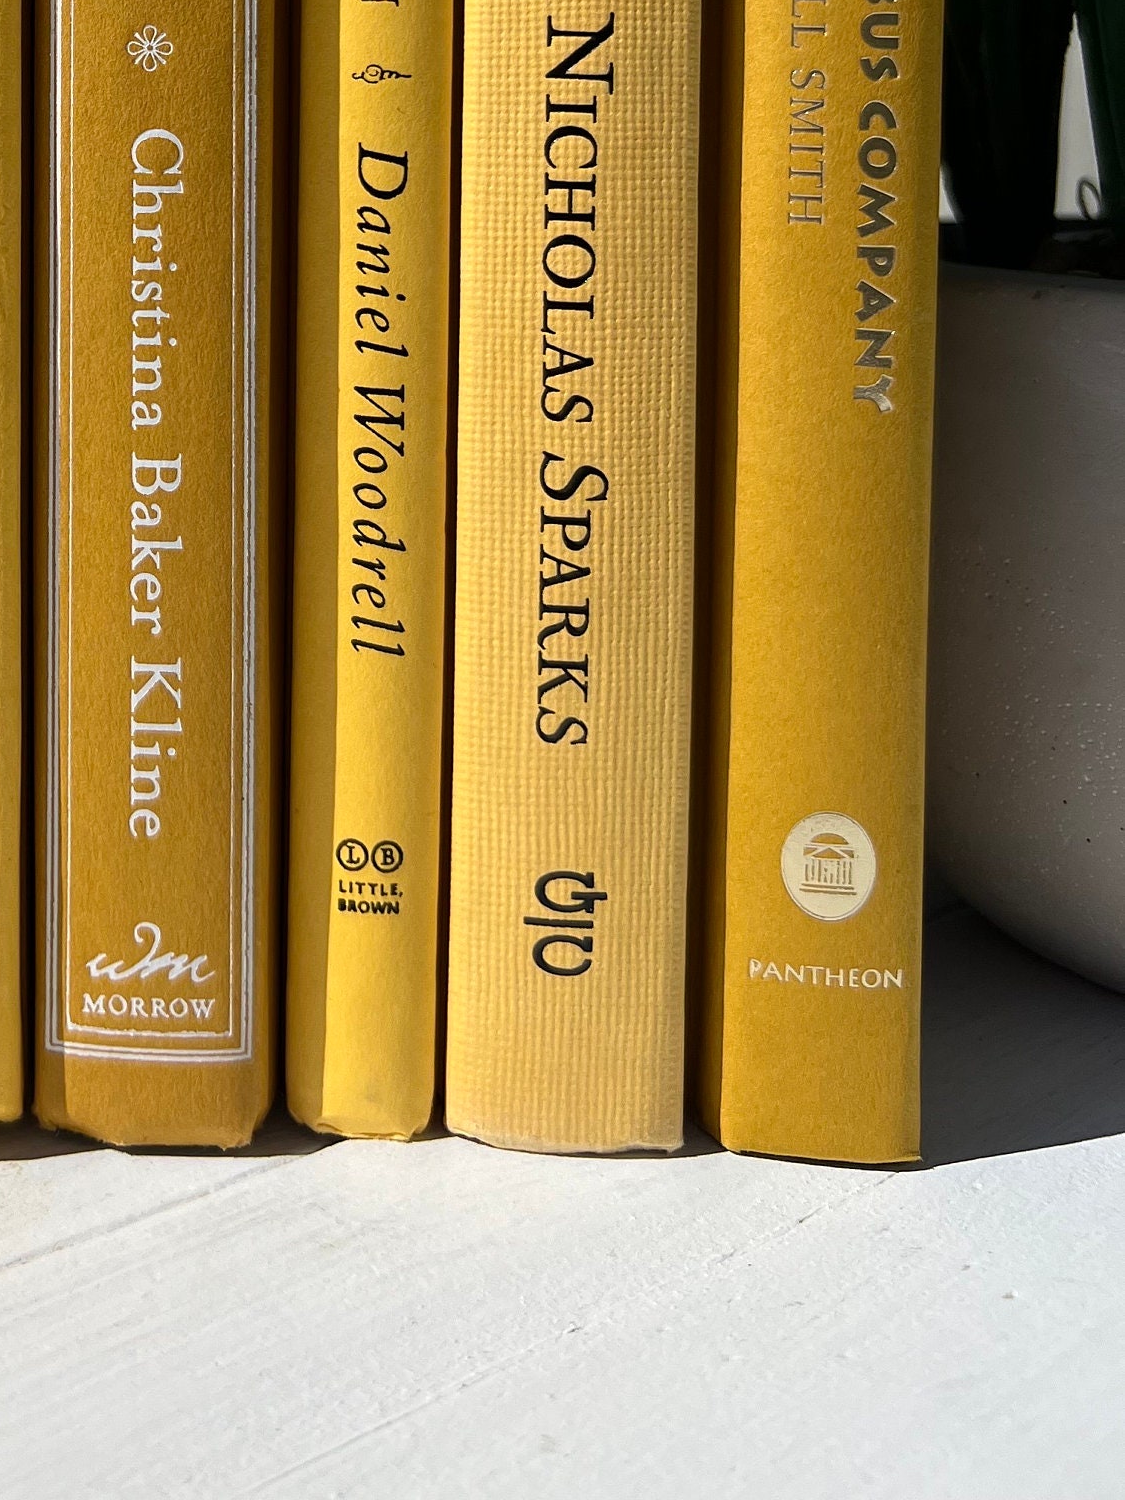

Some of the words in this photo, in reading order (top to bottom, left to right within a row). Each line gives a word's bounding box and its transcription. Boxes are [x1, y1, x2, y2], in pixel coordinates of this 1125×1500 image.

[540, 11, 616, 424] NICHOLAS
[786, 67, 828, 227] SMITH
[129, 127, 186, 431] Christina
[353, 141, 409, 360] Daniel
[852, 101, 898, 415] COMPANY
[129, 452, 185, 636] Baker
[351, 383, 407, 659] Woodrell
[535, 450, 610, 747] SPARKS
[127, 655, 185, 838] Kline
[337, 898, 400, 914] BROWN
[338, 878, 404, 898] LITTLE,
[748, 957, 903, 989] PANTHEON
[82, 992, 217, 1020] MORROW
